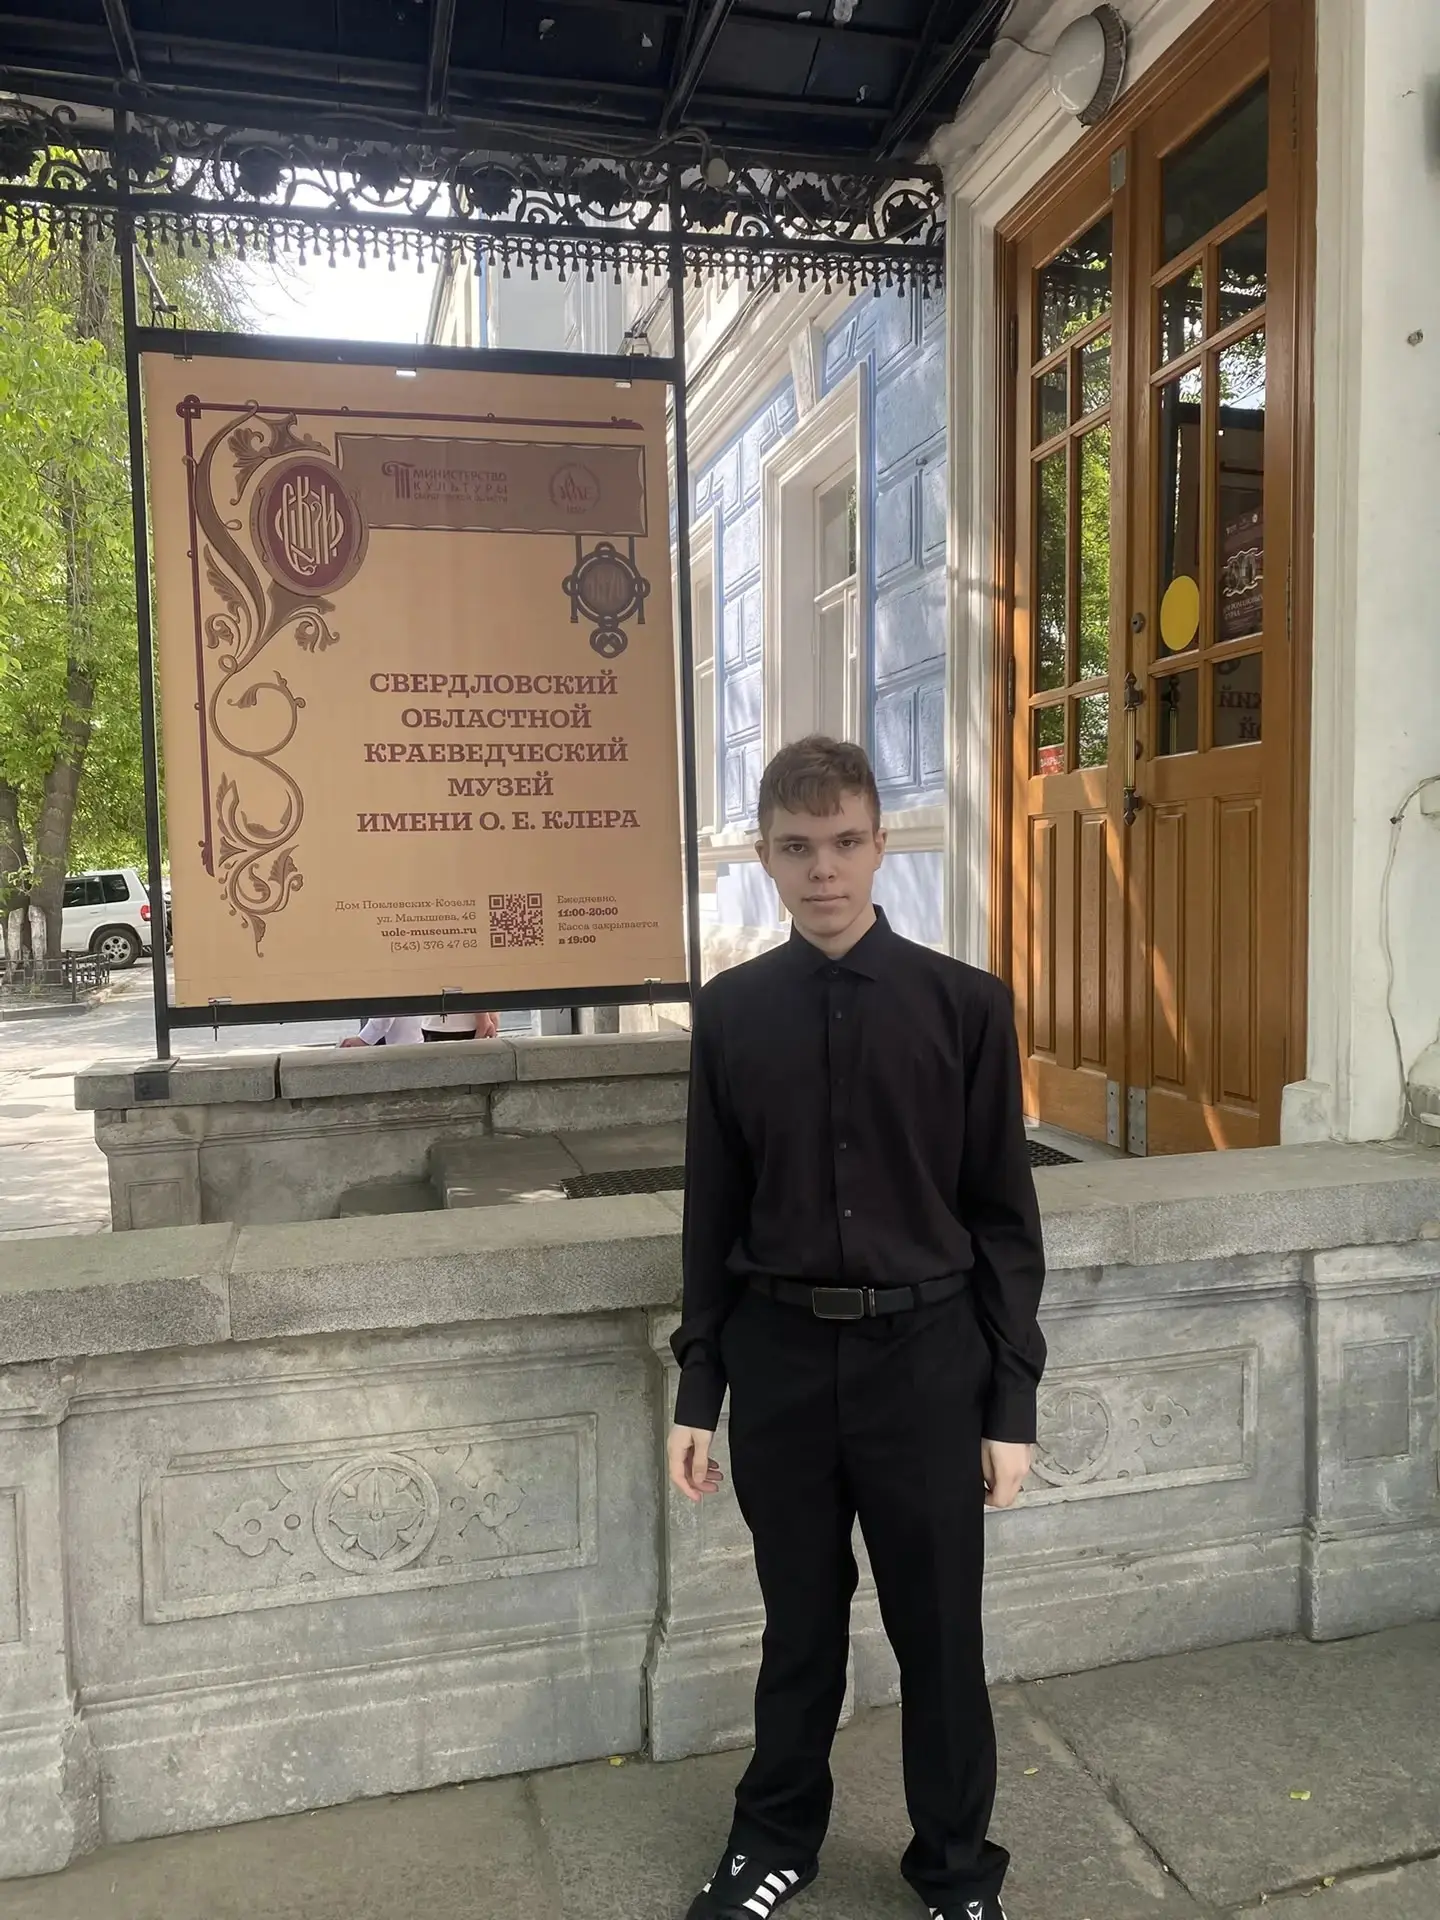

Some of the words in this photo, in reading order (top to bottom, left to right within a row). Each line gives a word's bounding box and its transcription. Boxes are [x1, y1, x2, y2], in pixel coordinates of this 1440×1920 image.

[413, 469, 507, 481] МИНИСТЕРСТВО
[413, 481, 507, 494] КУЛЬТУРЫ
[369, 669, 618, 698] СВЕРДЛОВСКИЙ
[401, 703, 592, 728] ОБЛАСТНОЙ
[364, 736, 629, 767] КРАЕВЕДЧЕСКИЙ
[447, 771, 554, 797] МУЗЕЙ
[357, 812, 473, 832] ИМЕНИ
[479, 811, 505, 831] О.
[512, 811, 535, 830] Е.
[542, 809, 640, 829] КЛЕРА
[335, 900, 361, 911] Дом
[363, 898, 476, 910] Поклевских-Козелл
[376, 914, 393, 925] ул.
[395, 911, 460, 924] Малышева,
[462, 911, 477, 921] 46
[557, 906, 619, 918] 11:00-20:00
[381, 926, 477, 937] uole-museum.ru
[558, 921, 588, 931] Касса
[591, 919, 659, 933] закрывается
[390, 940, 420, 952] (343)
[423, 940, 444, 950] 376
[446, 939, 462, 949] 47
[462, 939, 478, 949] 62
[566, 935, 597, 945] 19:00
